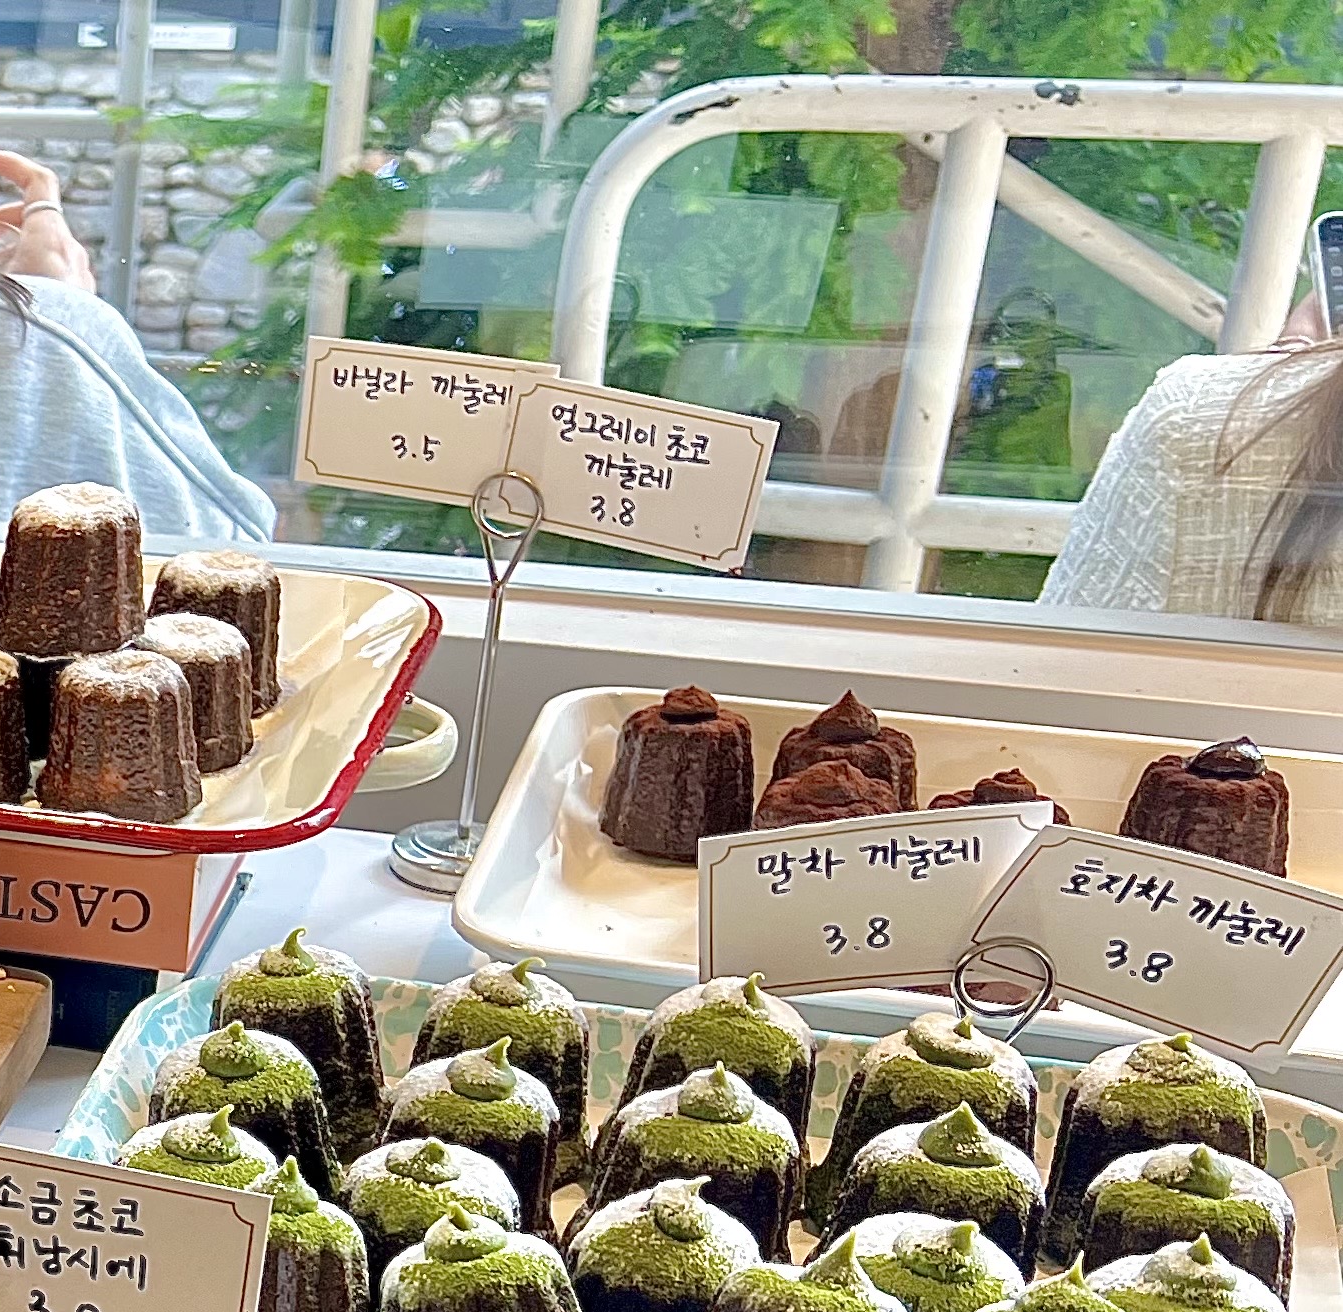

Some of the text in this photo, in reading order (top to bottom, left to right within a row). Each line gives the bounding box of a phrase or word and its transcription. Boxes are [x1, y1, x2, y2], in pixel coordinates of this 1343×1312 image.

[333, 365, 514, 415] 바닐라 까눌레
[391, 435, 441, 462] 3.5
[551, 403, 710, 465] 얼그레이 초코
[584, 452, 673, 491] 까눌레
[590, 495, 636, 527] 3.8
[757, 835, 981, 895] 말차 까눌레
[1060, 859, 1306, 956] 호지차 까눌레
[823, 917, 891, 955] 3.8
[1105, 939, 1174, 983] 3.8
